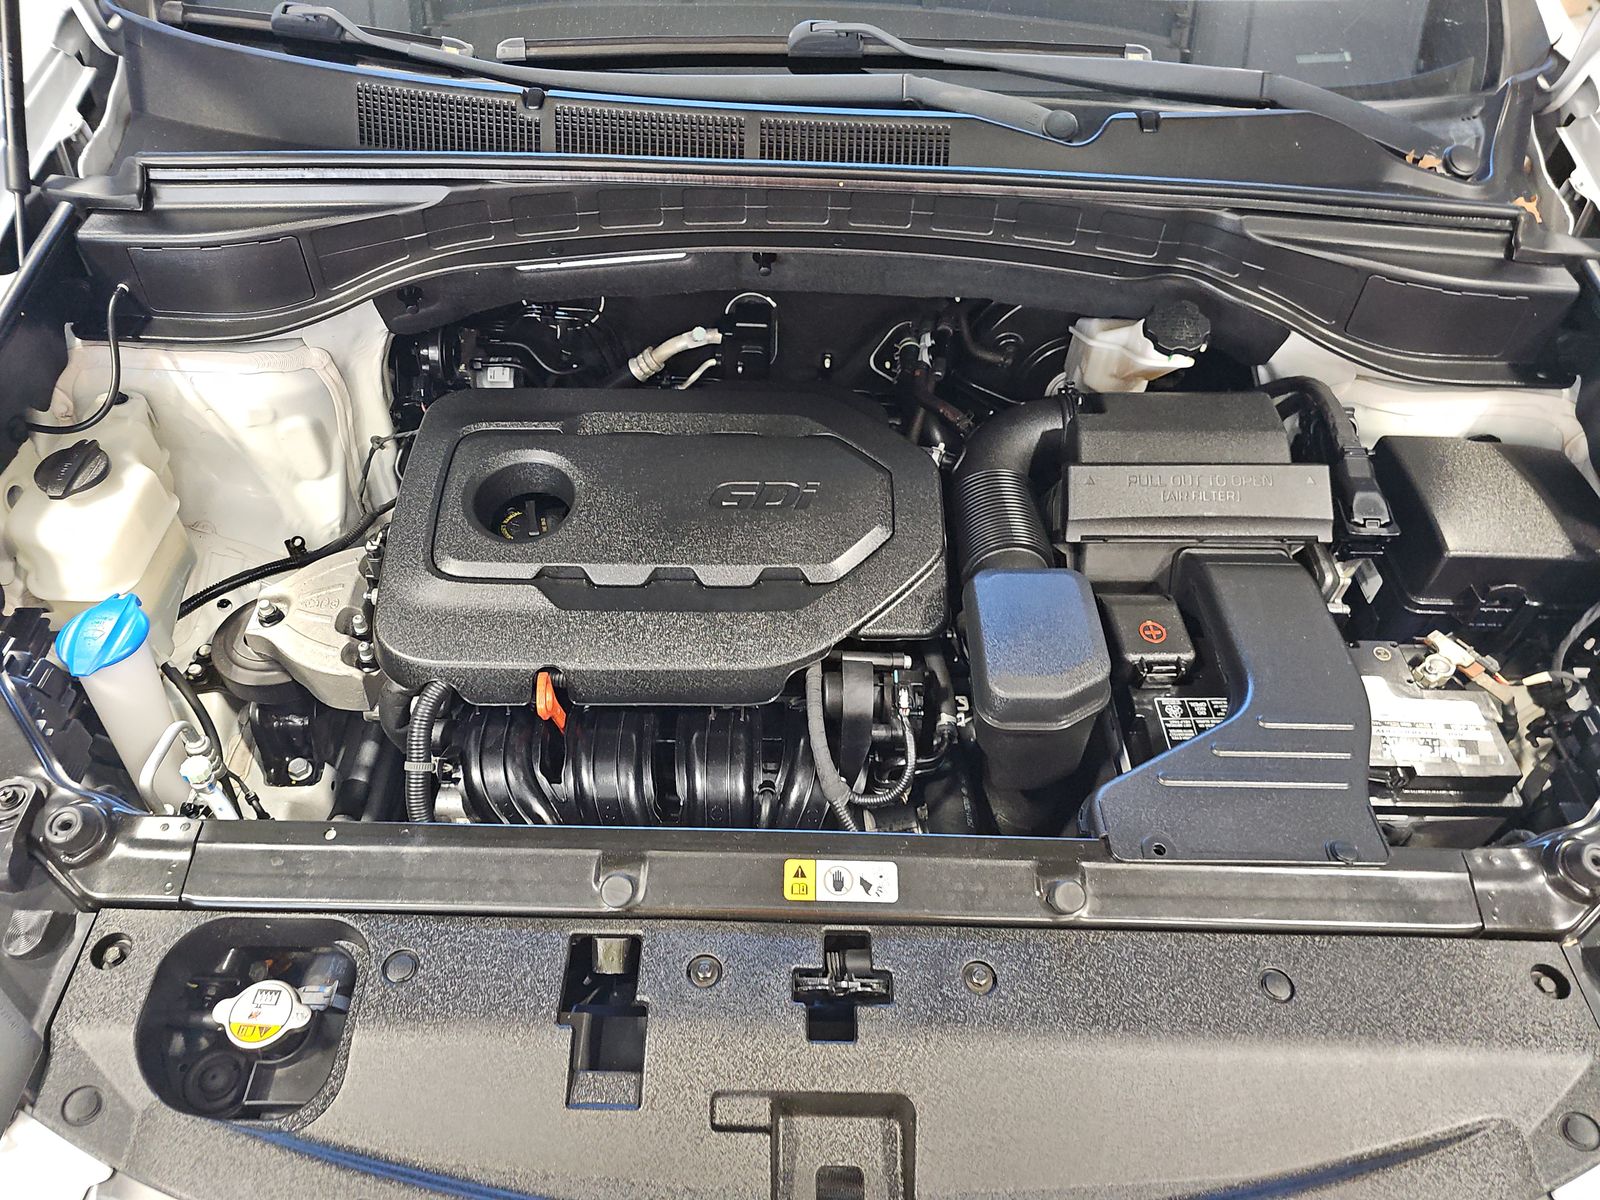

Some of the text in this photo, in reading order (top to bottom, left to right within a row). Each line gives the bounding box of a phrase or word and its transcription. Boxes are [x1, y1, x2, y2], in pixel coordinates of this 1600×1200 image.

[1127, 474, 1274, 487] PULL OUT TO OPEN
